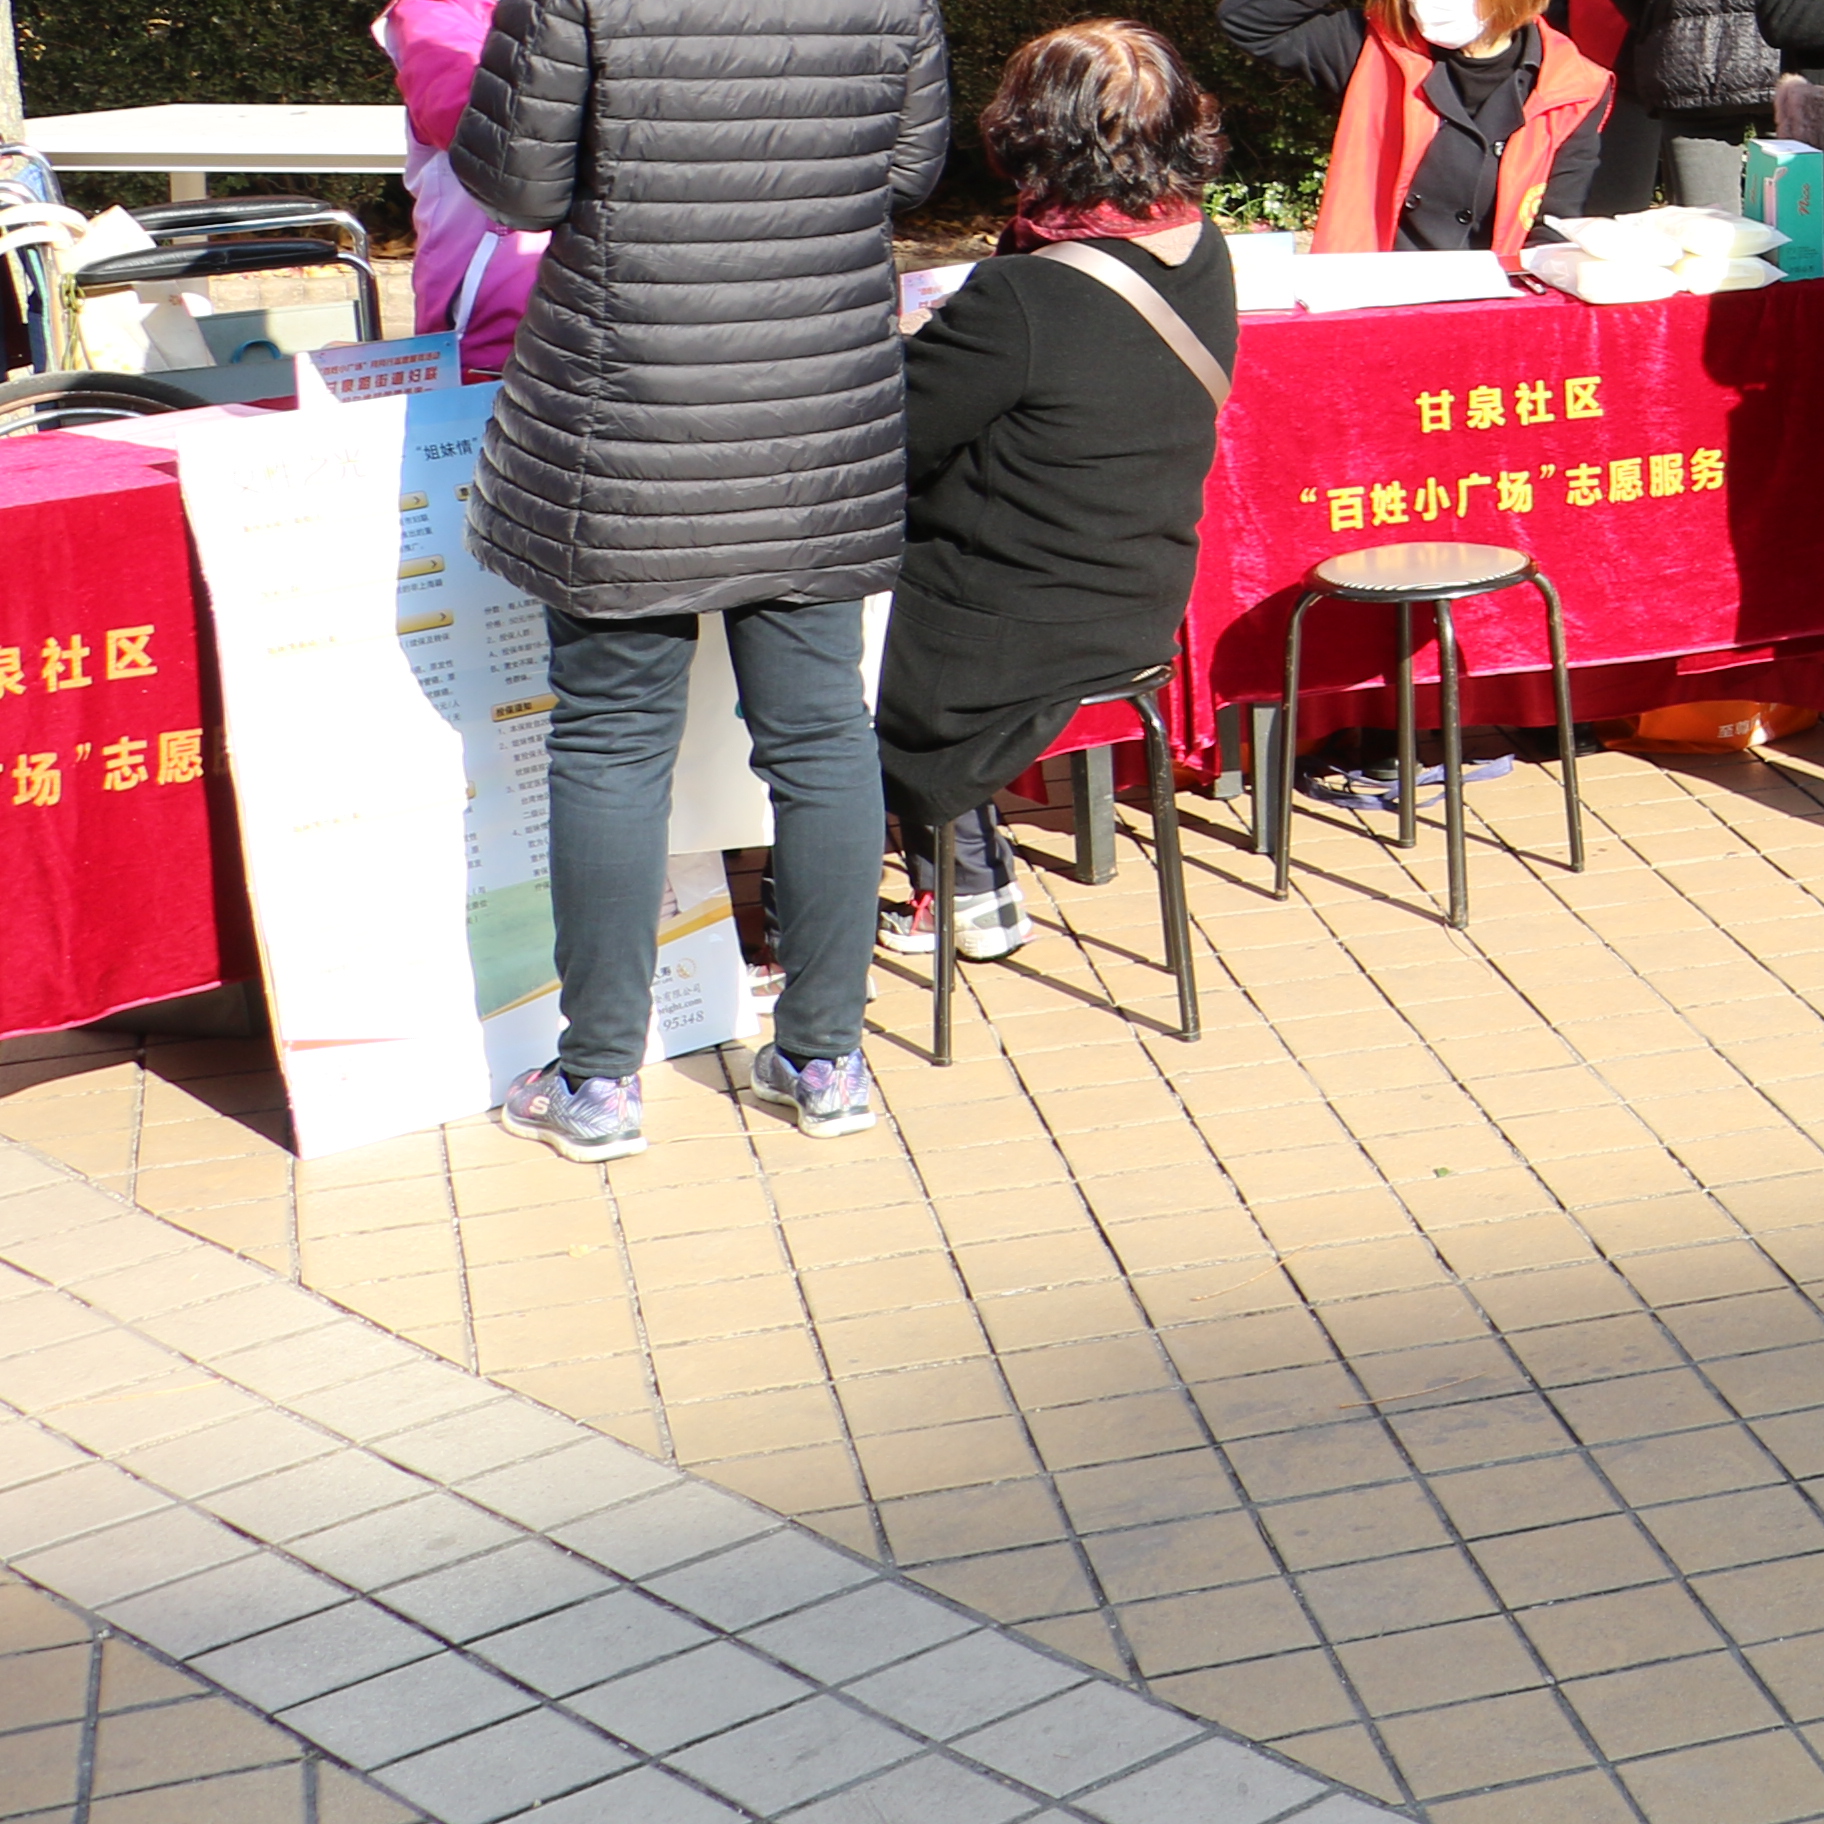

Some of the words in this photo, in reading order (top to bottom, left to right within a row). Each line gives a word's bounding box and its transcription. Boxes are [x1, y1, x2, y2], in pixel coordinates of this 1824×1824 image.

[1415, 376, 1603, 433] 甘泉社区
[415, 437, 479, 461] “姐妹情”
[1299, 447, 1726, 532] “百姓小广场”志愿服务
[0, 728, 204, 807] 场”志愿
[663, 1010, 704, 1031] 95348
